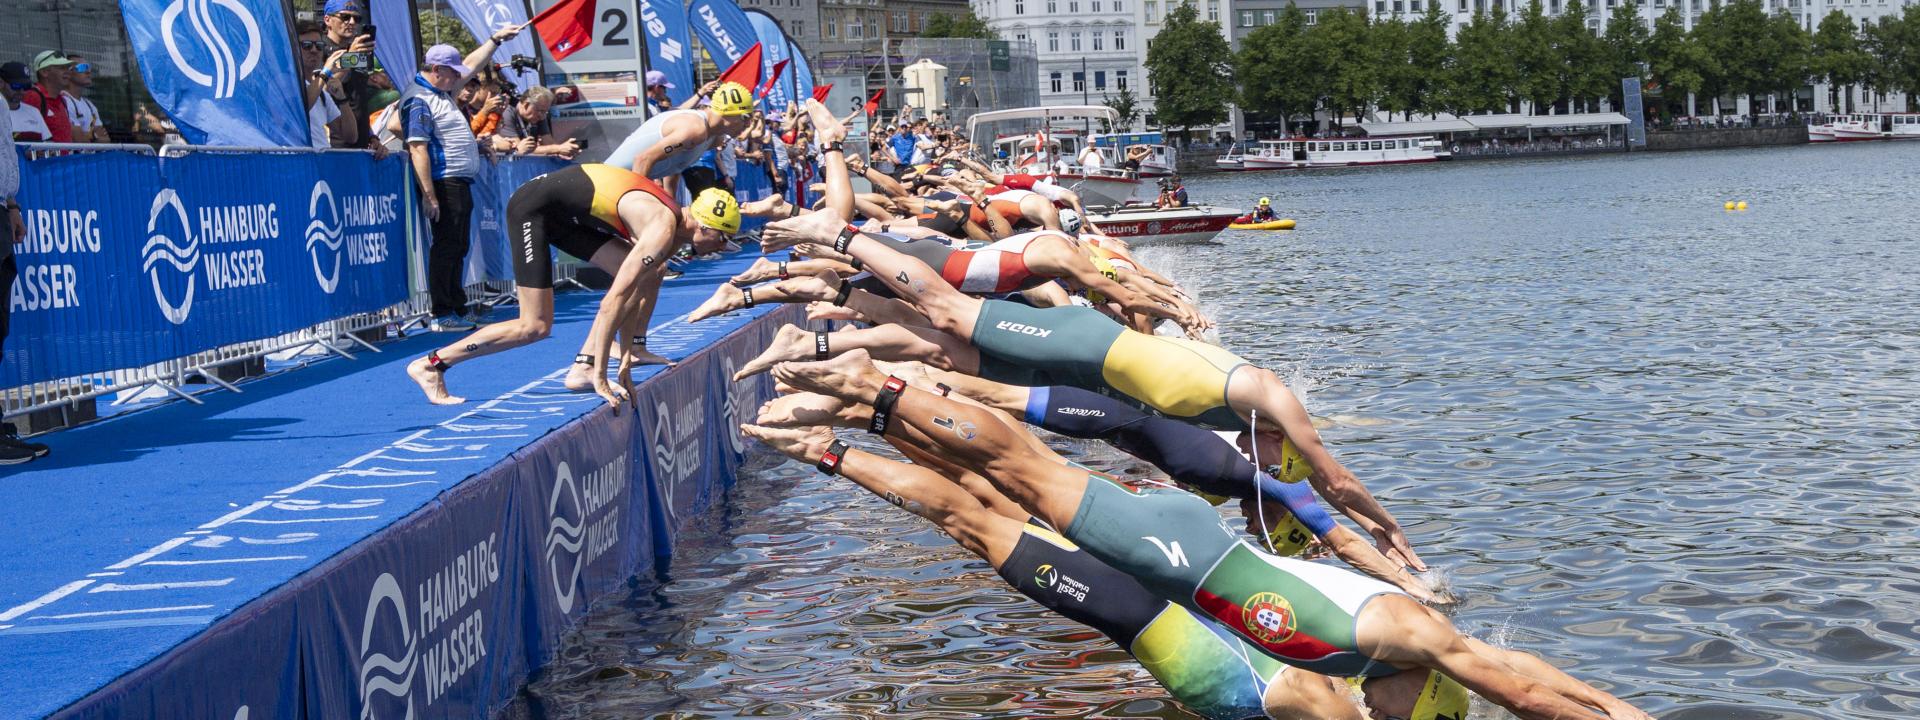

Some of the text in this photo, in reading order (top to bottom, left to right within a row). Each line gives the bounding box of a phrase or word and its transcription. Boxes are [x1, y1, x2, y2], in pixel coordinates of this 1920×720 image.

[601, 8, 629, 46] 2
[720, 88, 743, 105] 10
[851, 96, 863, 111] 3
[712, 200, 727, 218] 8
[13, 209, 101, 254] MBURG
[199, 202, 279, 244] HAMBURG
[1067, 215, 1081, 232] 19
[346, 232, 389, 266] WASSER
[522, 221, 534, 264] CANYON
[203, 248, 266, 291] WASSER
[642, 255, 654, 266] 8
[10, 263, 80, 313] ASSER
[896, 271, 910, 285] 4
[996, 320, 1053, 338] KODA
[932, 415, 956, 431] 1
[583, 451, 627, 516] HAMBUR
[1288, 528, 1307, 546] 5
[419, 532, 499, 639] HAMBURG
[1056, 582, 1086, 603] Brasil
[1062, 574, 1090, 593] triathlon
[423, 608, 487, 706] WASSER
